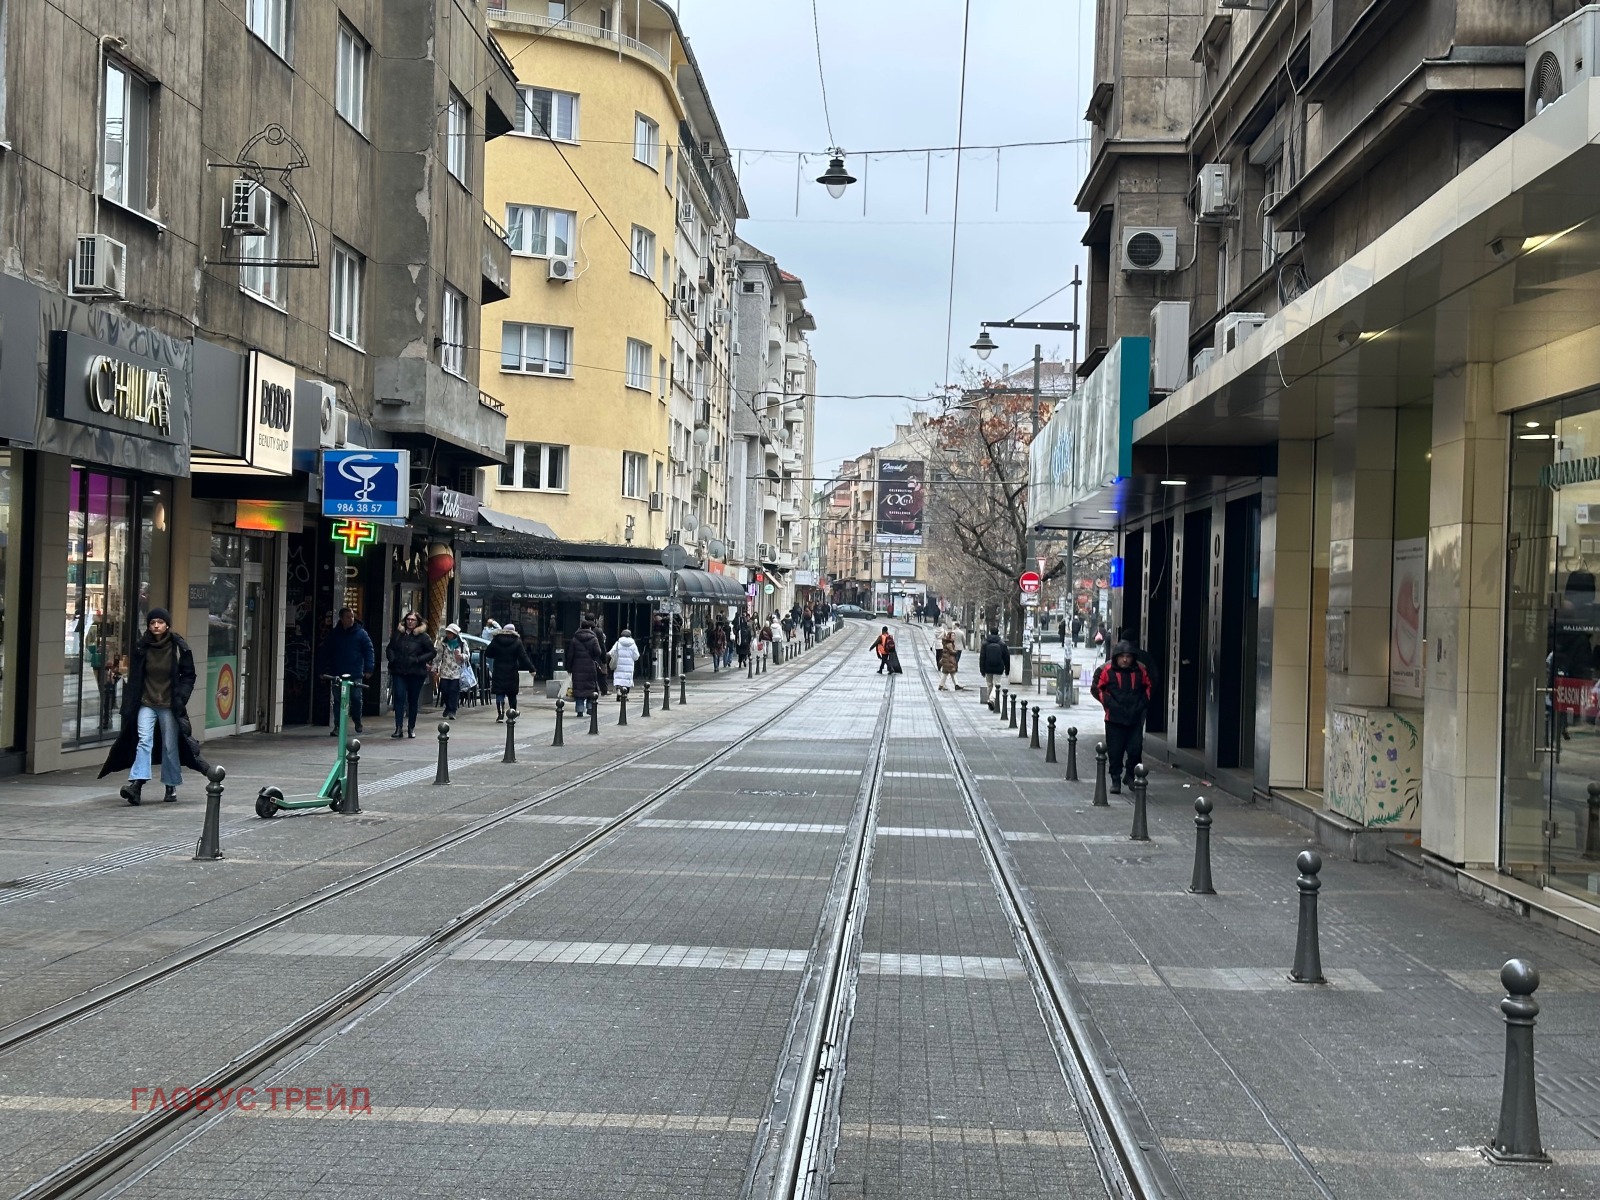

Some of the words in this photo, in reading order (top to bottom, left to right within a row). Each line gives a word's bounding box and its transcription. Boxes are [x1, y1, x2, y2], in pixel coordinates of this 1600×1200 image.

[260, 379, 292, 433] BOBO
[258, 433, 276, 451] BEAUTY
[276, 437, 289, 453] SHOP
[337, 503, 354, 512] 986
[356, 503, 368, 513] 38
[370, 504, 383, 513] 57
[1210, 533, 1221, 703] ОПТИКА
[1556, 685, 1580, 706] SEASON
